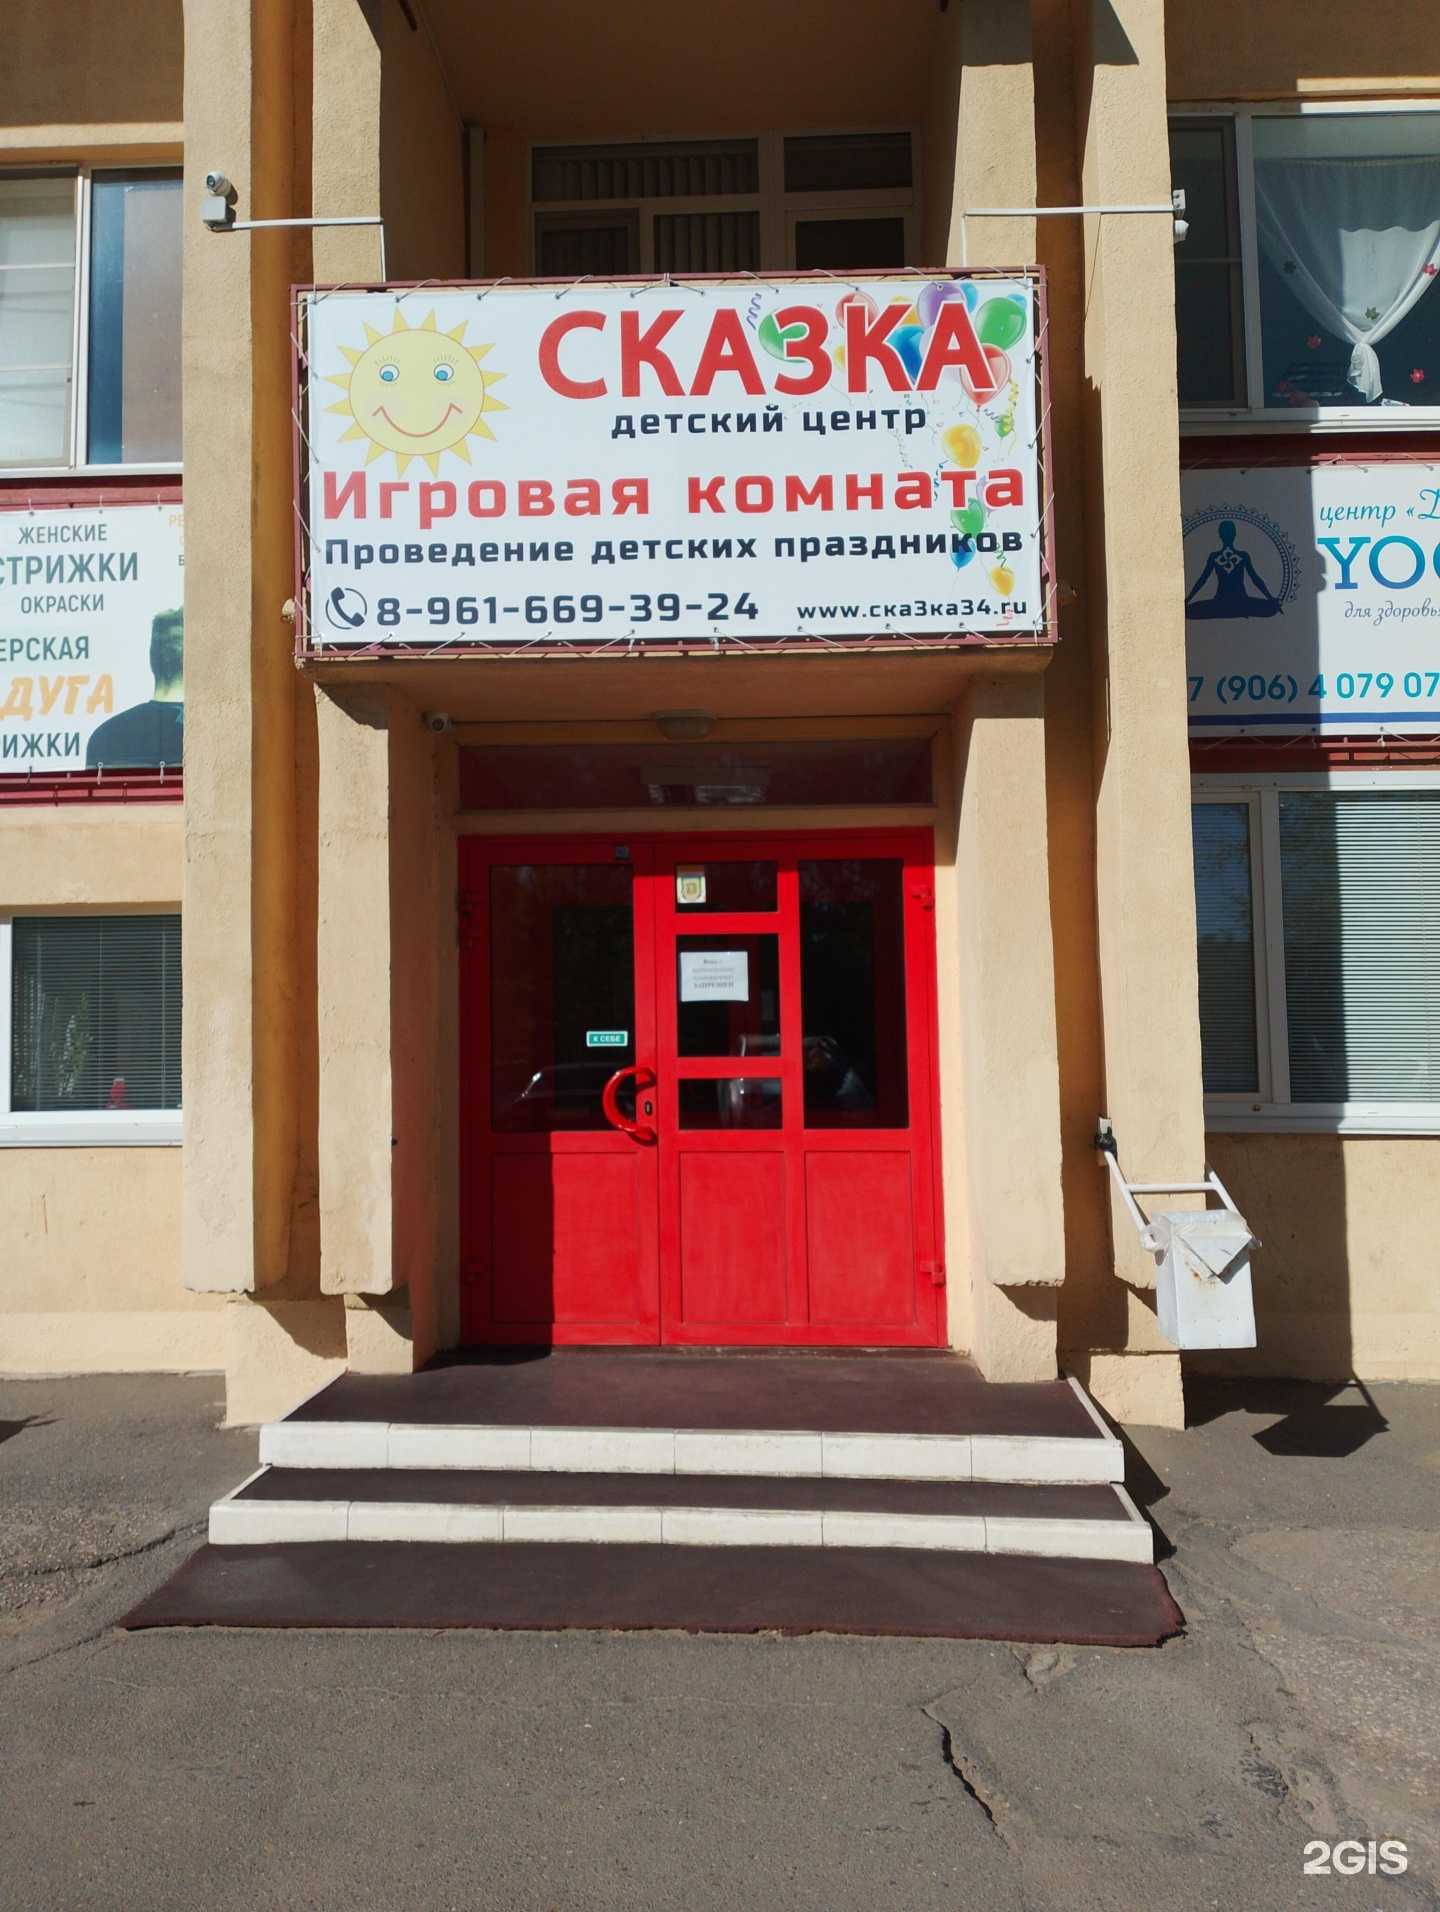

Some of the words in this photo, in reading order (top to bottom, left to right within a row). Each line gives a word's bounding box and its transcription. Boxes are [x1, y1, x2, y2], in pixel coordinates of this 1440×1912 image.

[538, 303, 995, 399] СКАЗКА
[611, 404, 784, 439] детский
[803, 408, 926, 436] центр
[323, 471, 649, 529] Игровая
[687, 468, 1024, 514] комната
[1319, 503, 1396, 528] центр
[18, 523, 108, 544] ЖЕНСКИЕ
[325, 538, 574, 569] Проведение
[591, 537, 757, 565] детских
[774, 531, 1023, 563] праздников
[1317, 535, 1440, 590] YO
[20, 594, 104, 614] ОКРАСКИ
[376, 592, 759, 626] 8-961-669-39-24
[1344, 601, 1372, 618] для
[1216, 675, 1298, 704] (906)
[1308, 674, 1327, 699] 4
[1335, 672, 1394, 699] 079
